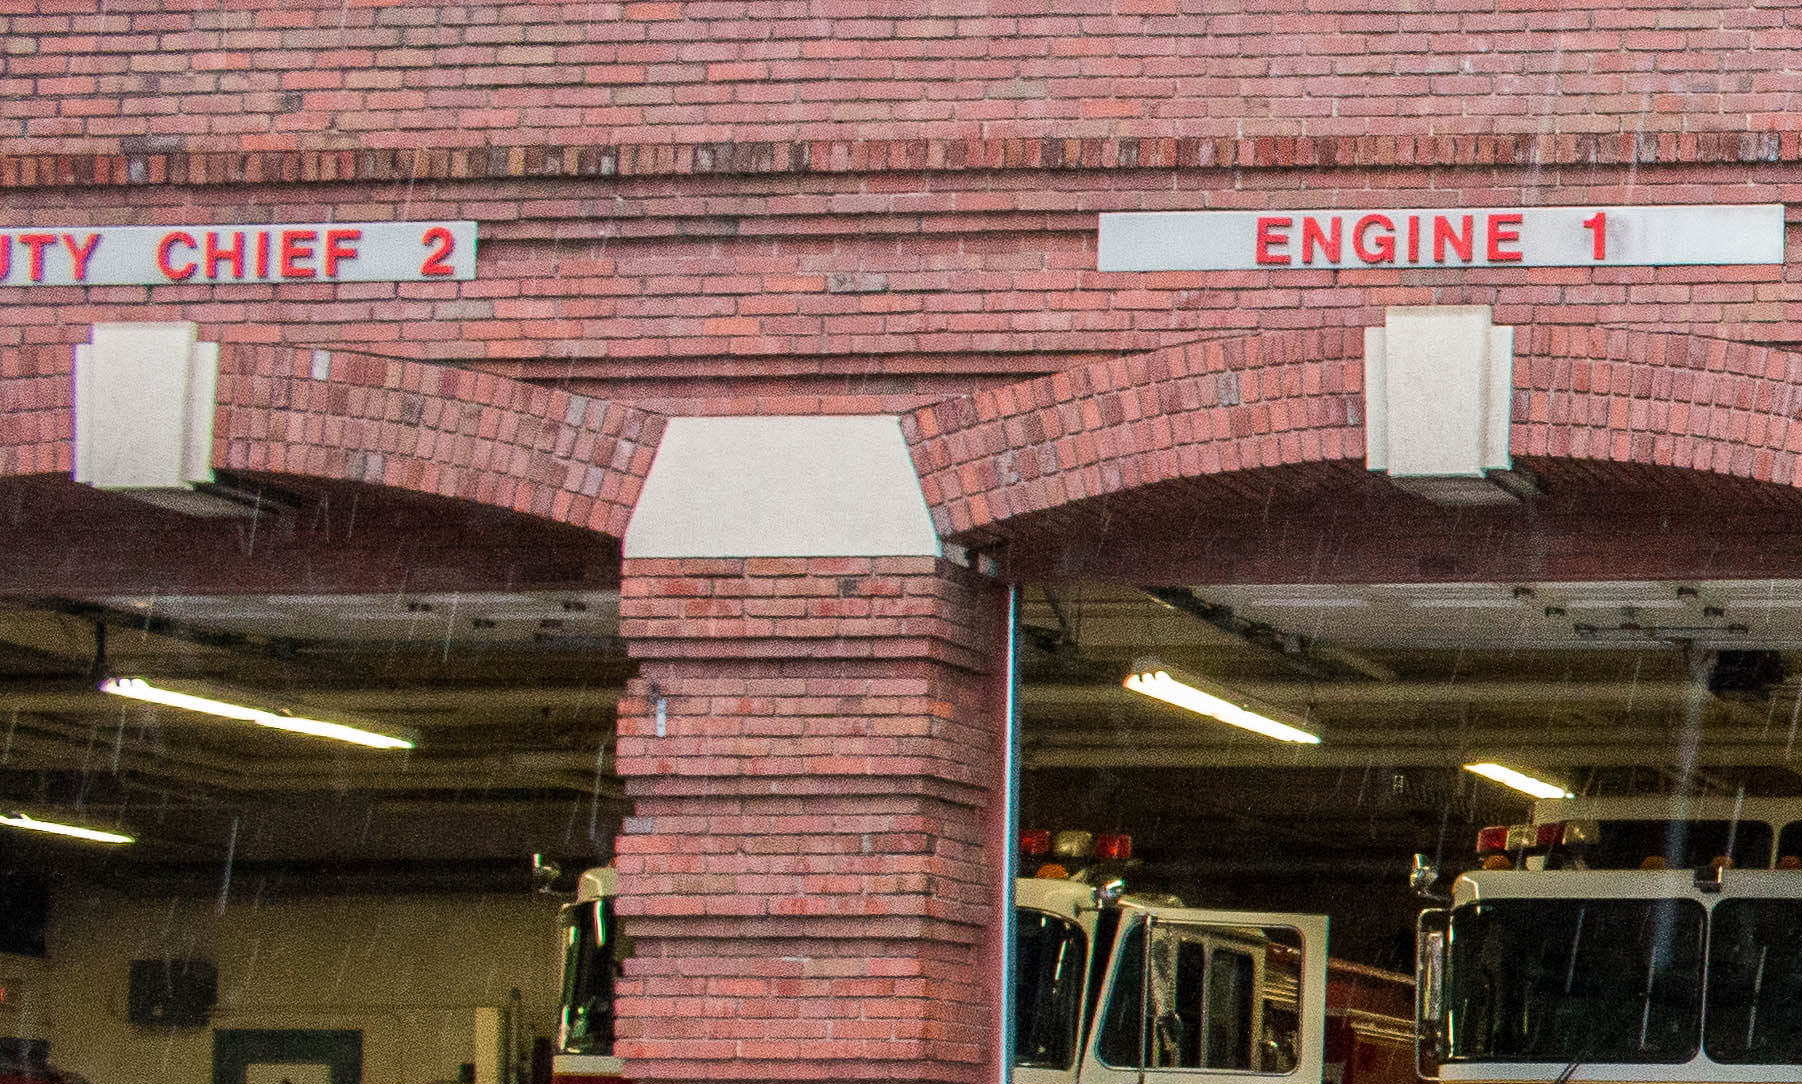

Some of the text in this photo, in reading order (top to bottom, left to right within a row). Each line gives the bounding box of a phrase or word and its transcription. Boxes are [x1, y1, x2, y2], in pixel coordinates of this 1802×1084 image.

[0, 226, 456, 283] TY CHIEF 2
[1254, 211, 1607, 265] ENGINE 1
